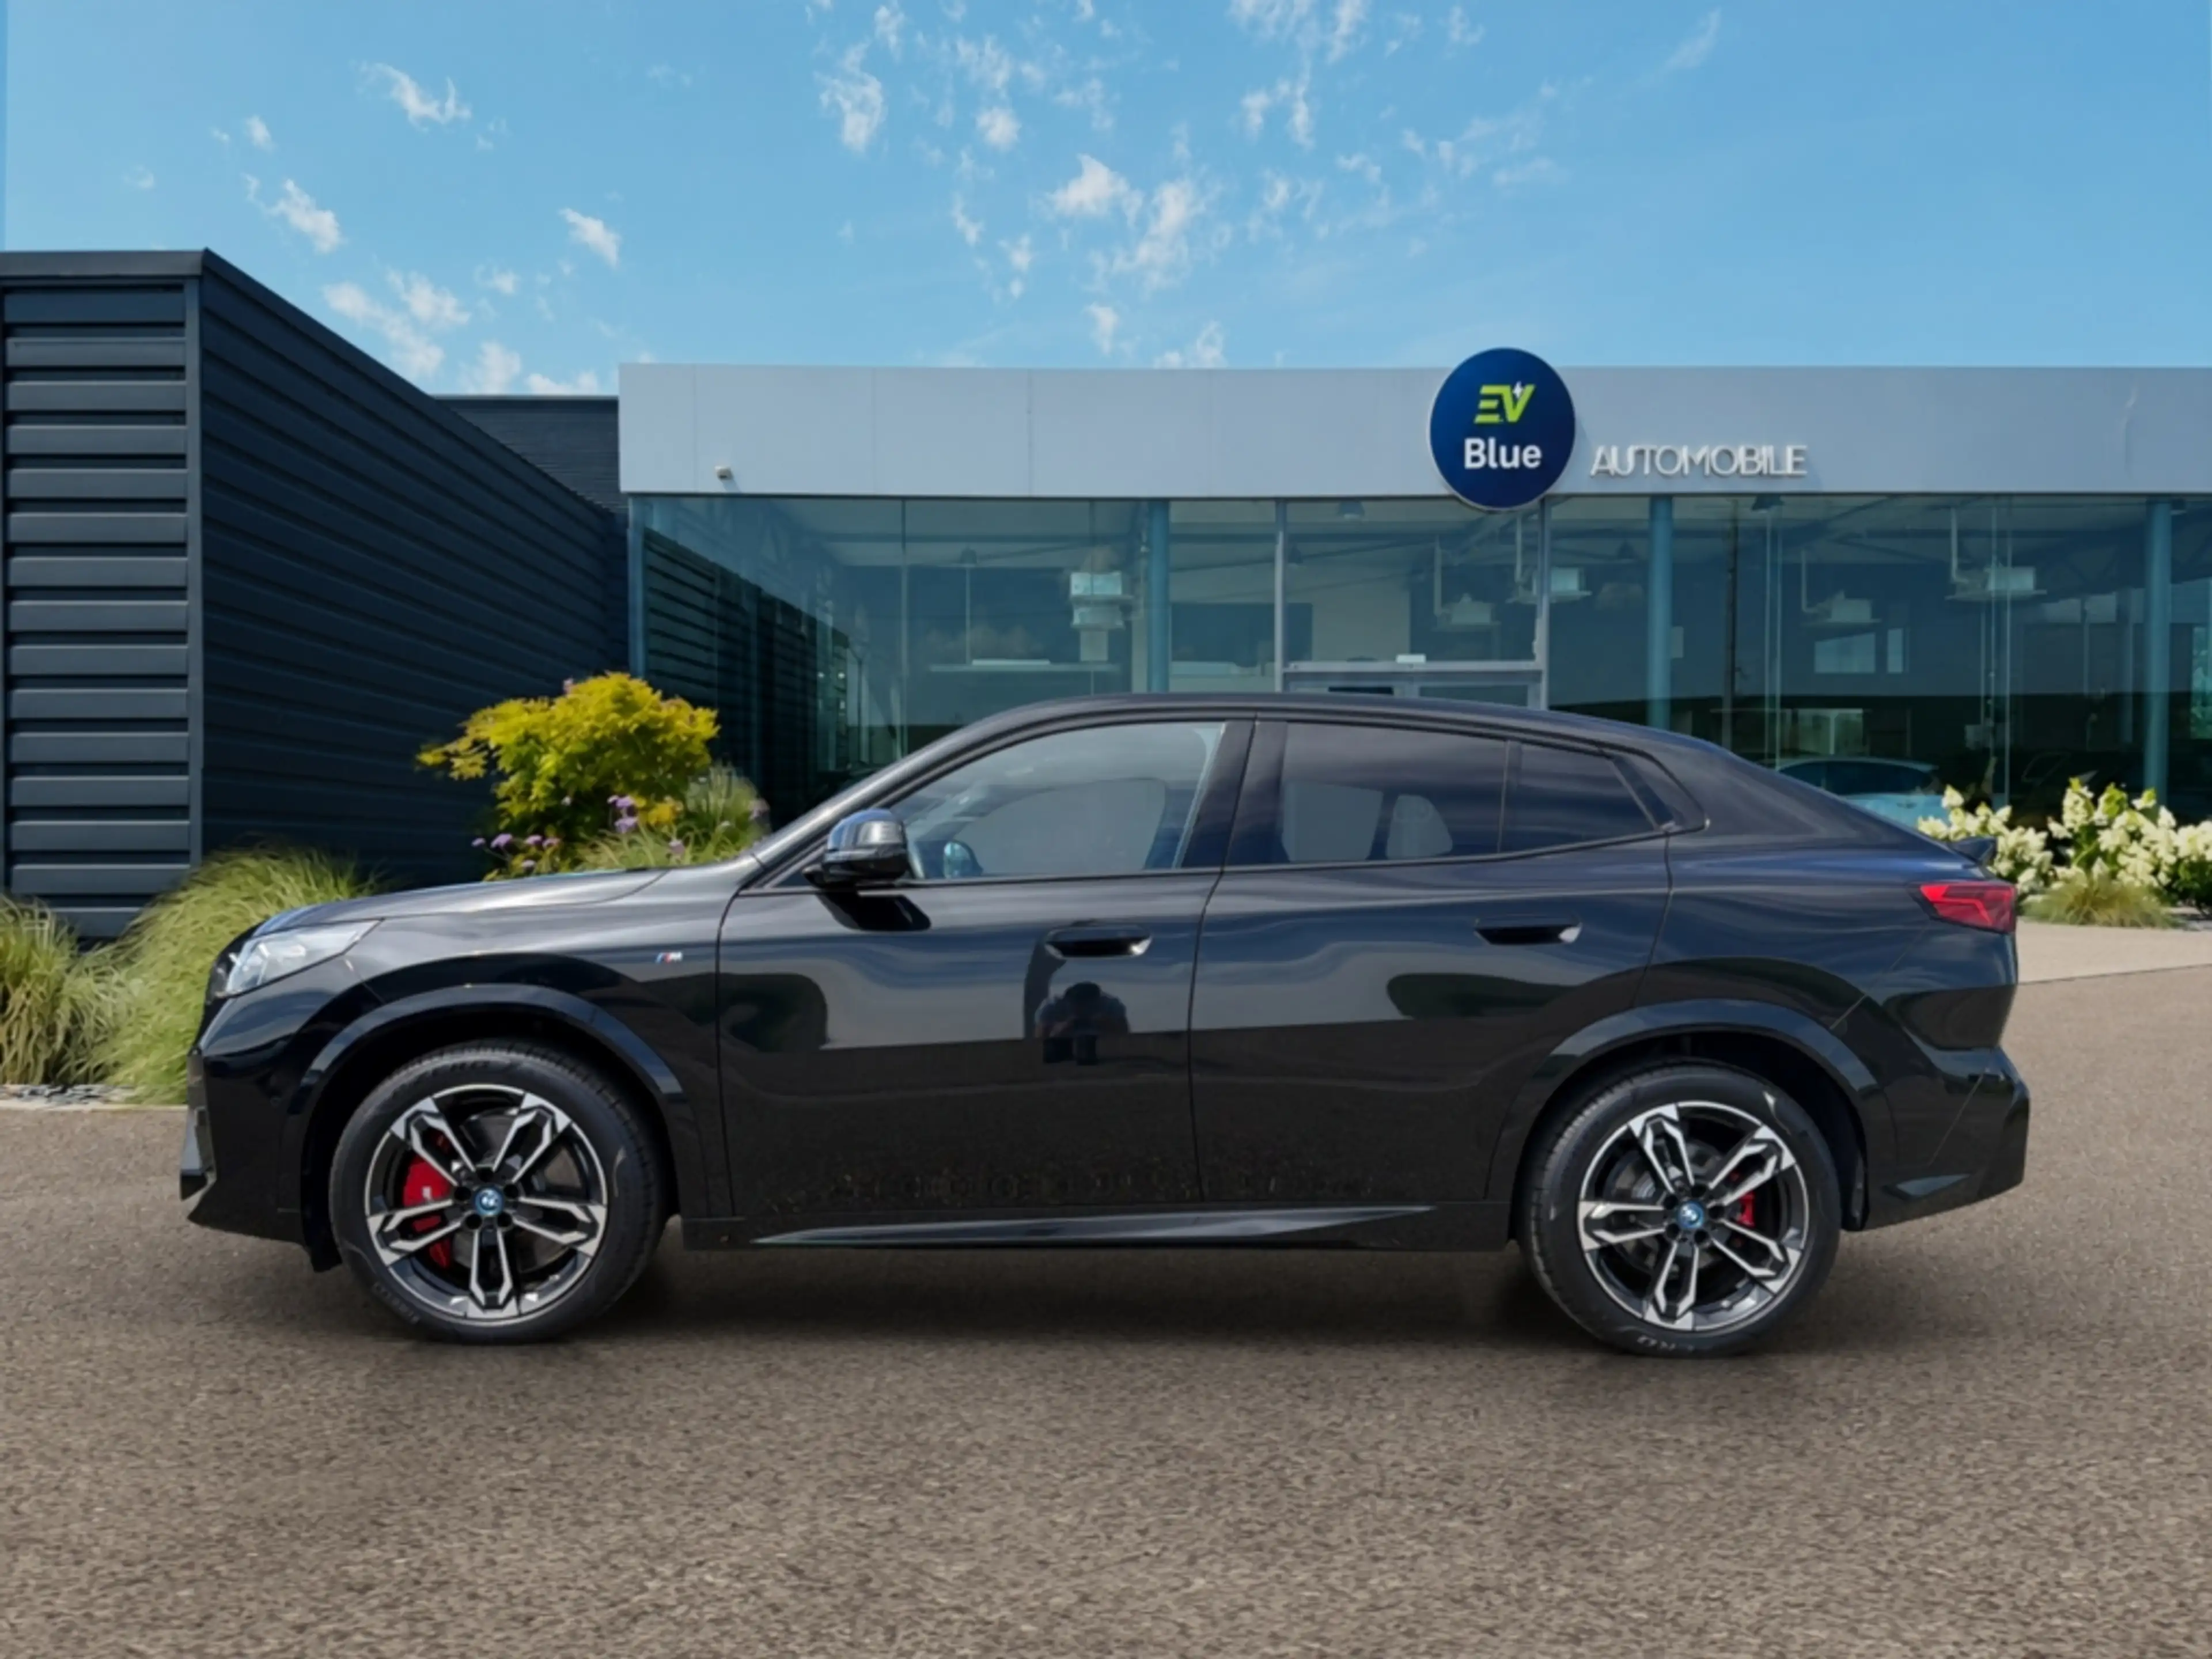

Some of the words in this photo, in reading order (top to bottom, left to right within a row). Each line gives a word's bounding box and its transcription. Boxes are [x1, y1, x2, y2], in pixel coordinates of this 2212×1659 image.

[1474, 383, 1536, 423] EV
[1464, 437, 1542, 469] Blue
[1590, 445, 1808, 476] AUTOMOBILE
